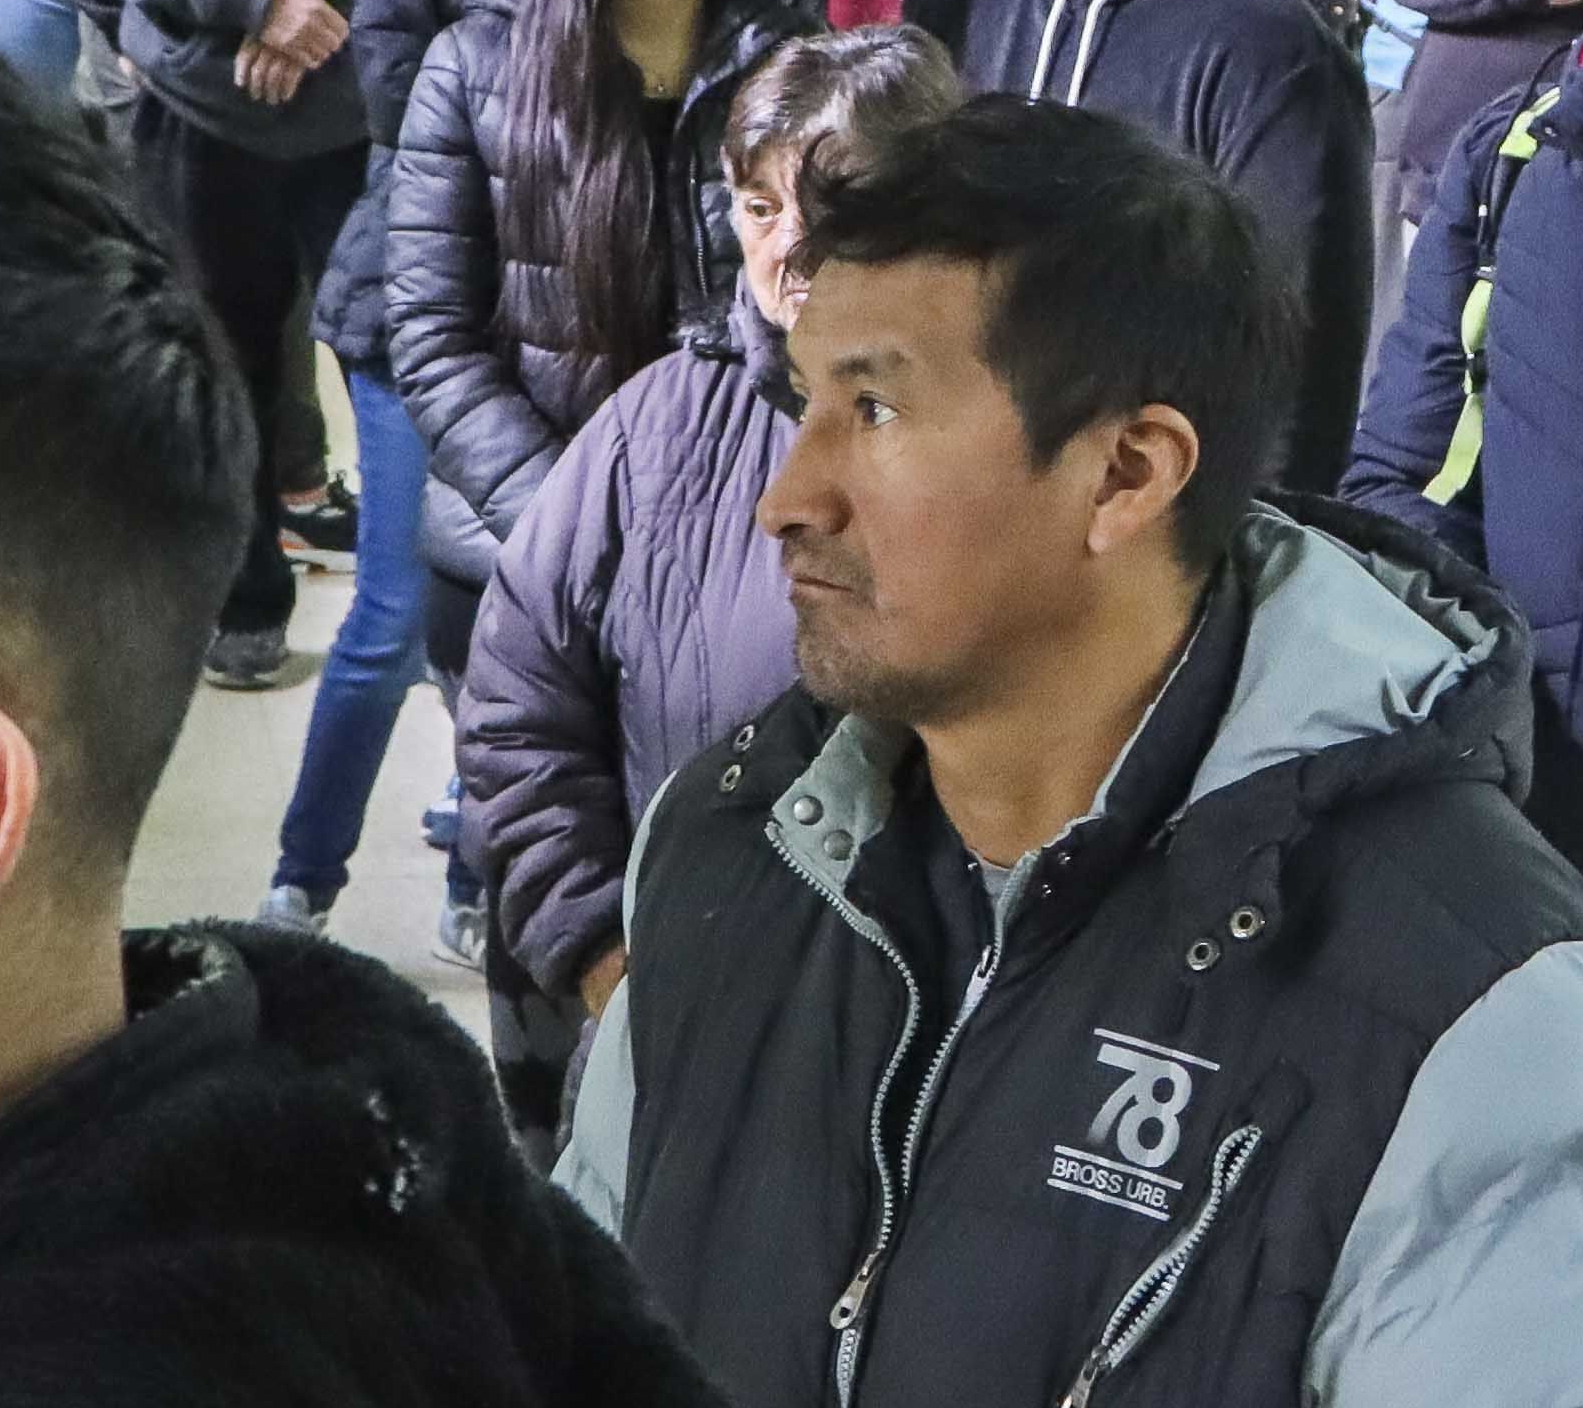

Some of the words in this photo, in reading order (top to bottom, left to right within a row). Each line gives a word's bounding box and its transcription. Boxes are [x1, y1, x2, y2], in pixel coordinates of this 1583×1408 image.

[1088, 1042, 1193, 1169] 78
[1051, 1156, 1124, 1195] BROSS
[1126, 1178, 1170, 1210] URB.
